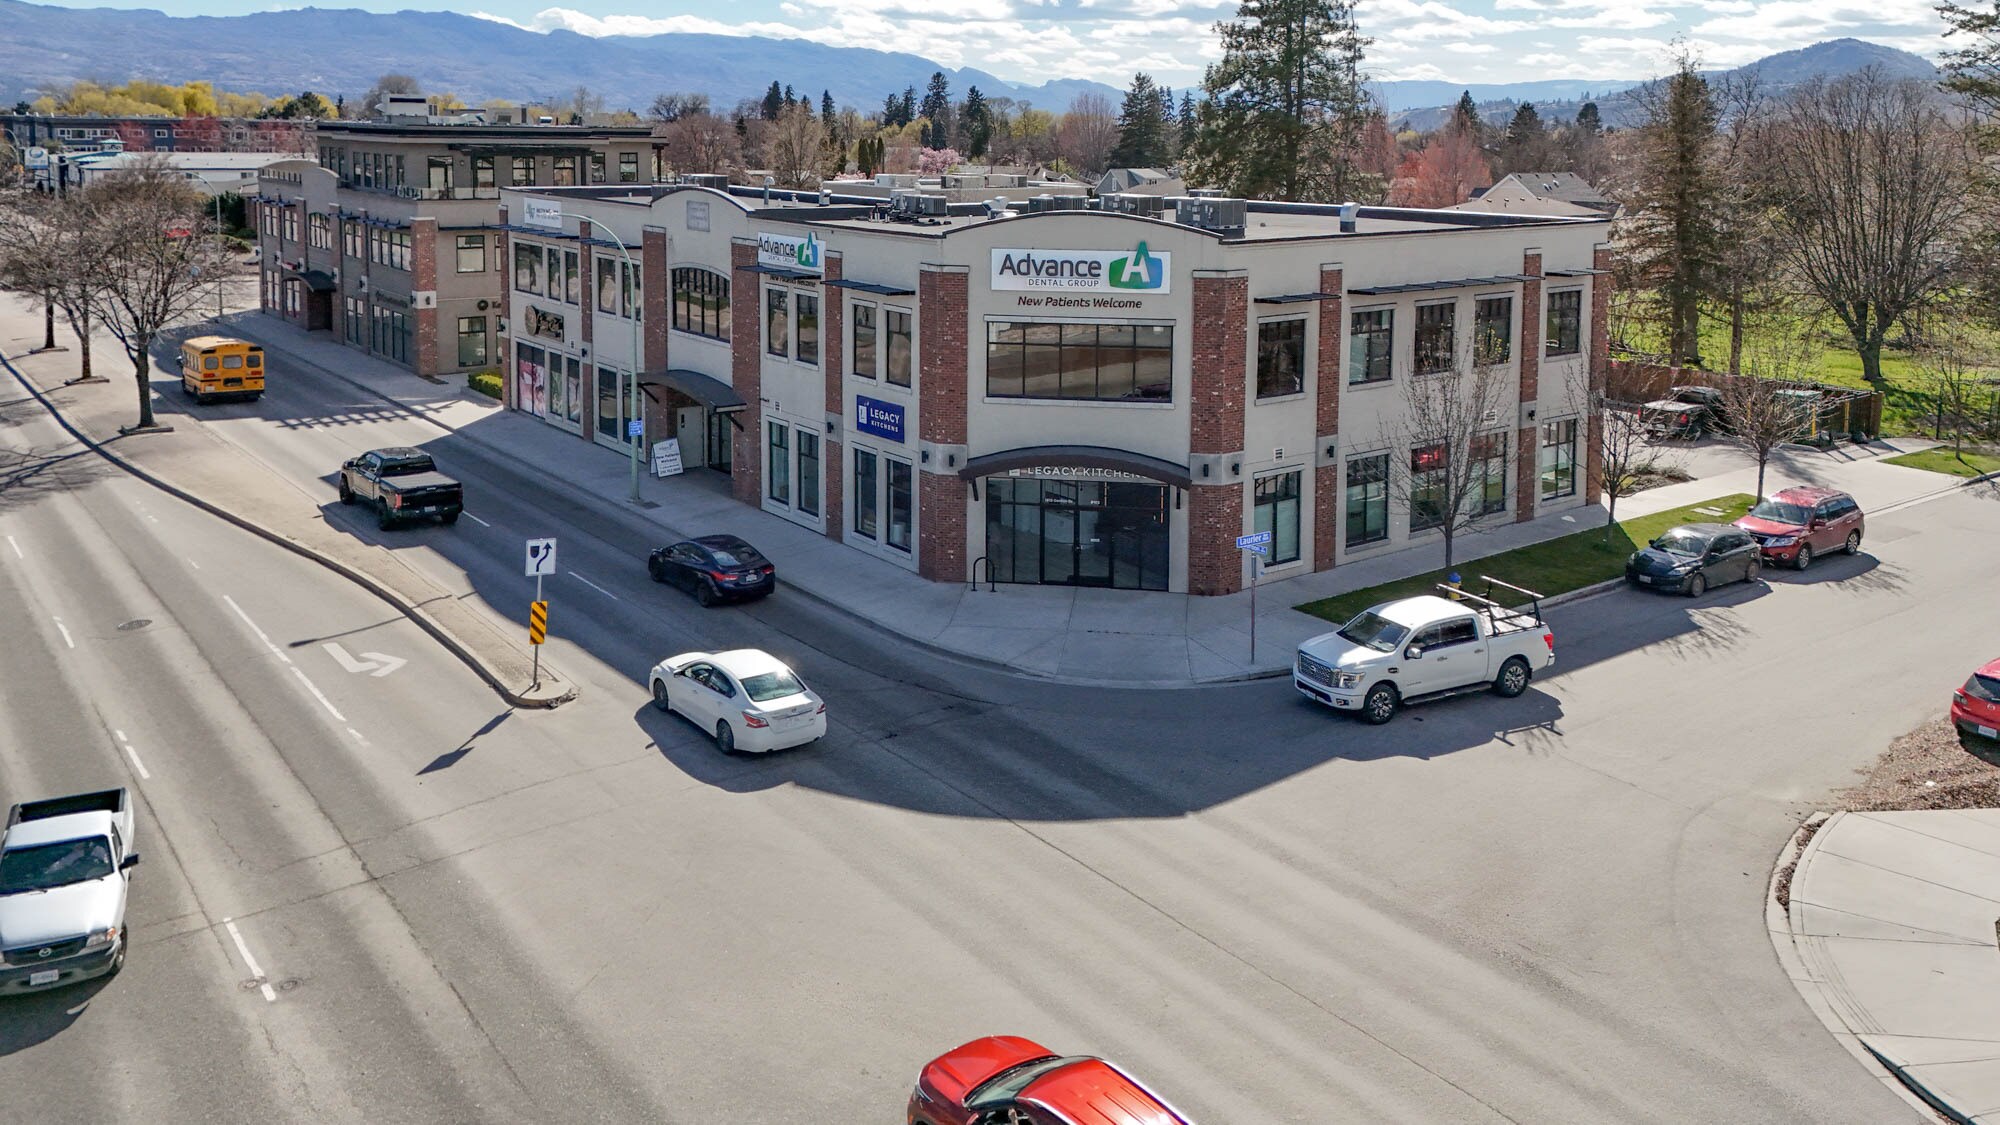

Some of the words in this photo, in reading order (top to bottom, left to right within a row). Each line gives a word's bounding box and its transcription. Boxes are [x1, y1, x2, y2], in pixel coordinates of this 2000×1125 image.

[758, 236, 796, 257] Advance
[999, 253, 1102, 278] Advance
[1028, 278, 1065, 287] DENTAL
[1067, 279, 1099, 288] GROUP
[1017, 296, 1044, 307] New
[1045, 296, 1091, 308] Patients
[1093, 297, 1143, 310] Welcome
[870, 407, 900, 424] LEGACY
[871, 420, 899, 433] KITCHENS
[1027, 466, 1078, 476] LEGACY
[1240, 534, 1262, 546] Laurier
